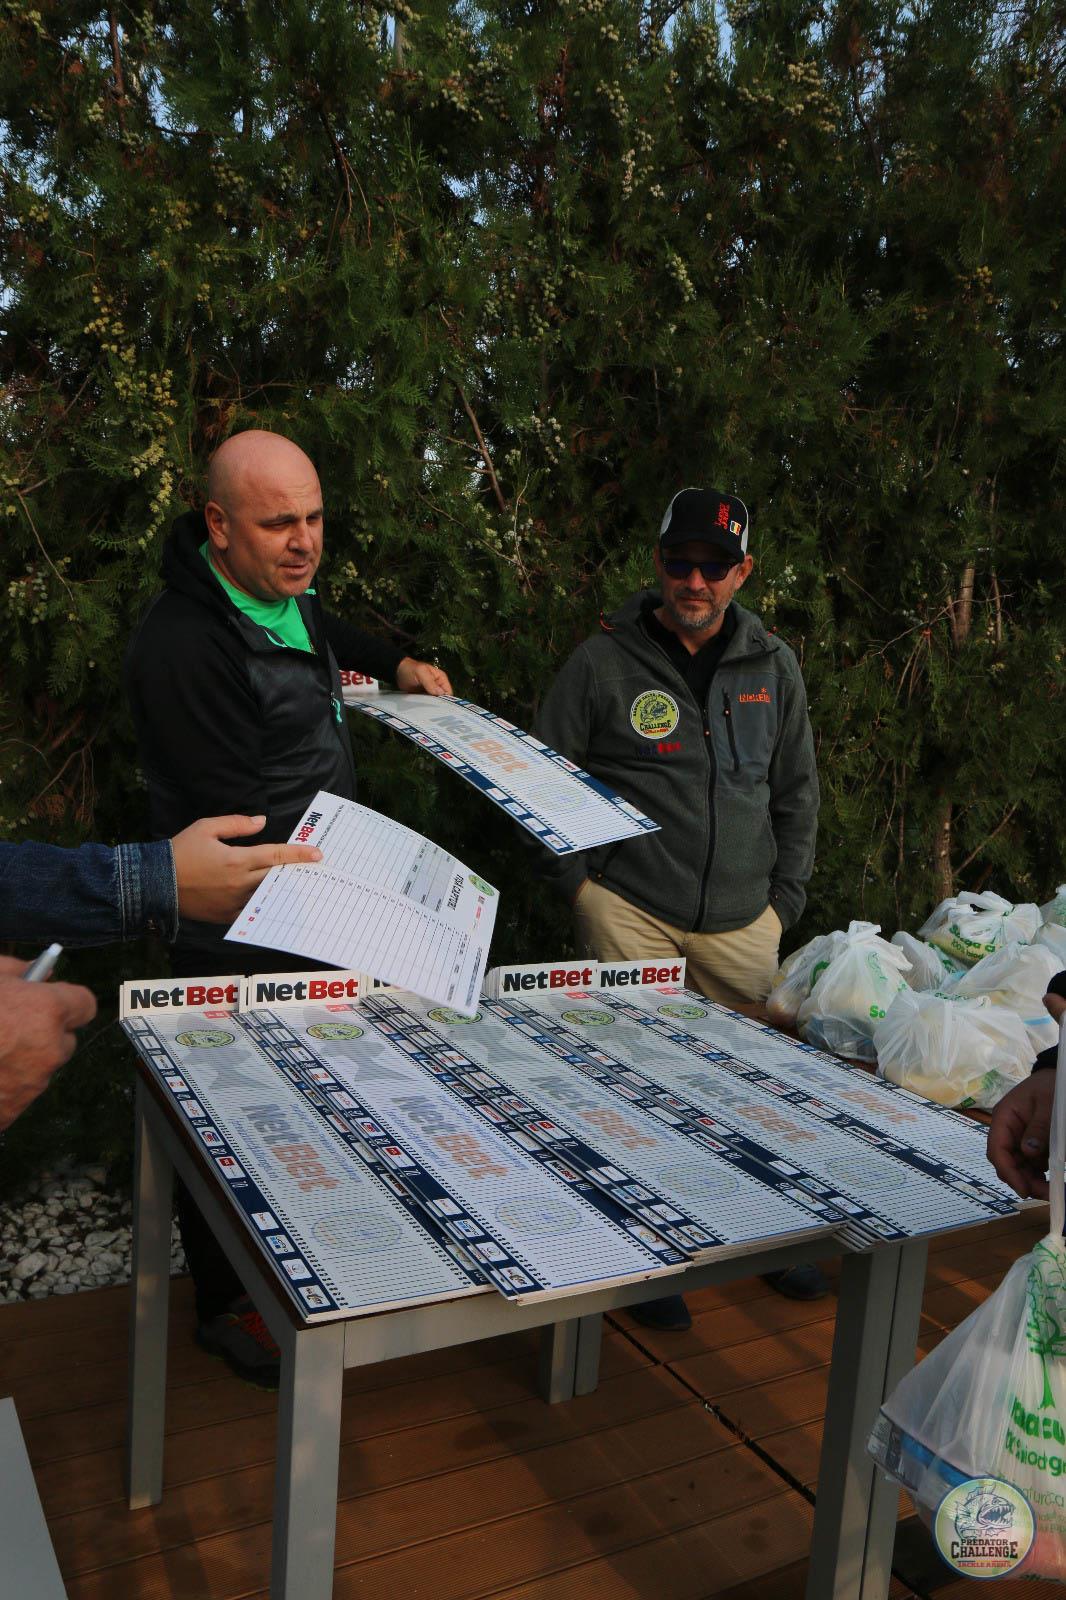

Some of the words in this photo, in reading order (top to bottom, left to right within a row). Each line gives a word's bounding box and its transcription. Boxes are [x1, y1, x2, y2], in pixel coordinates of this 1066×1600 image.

[340, 671, 374, 686] Bet
[295, 811, 323, 843] NetBet
[503, 967, 593, 992] NetBet
[600, 965, 682, 988] NetBet
[130, 984, 239, 1010] NetBet
[256, 978, 359, 1003] NetBet
